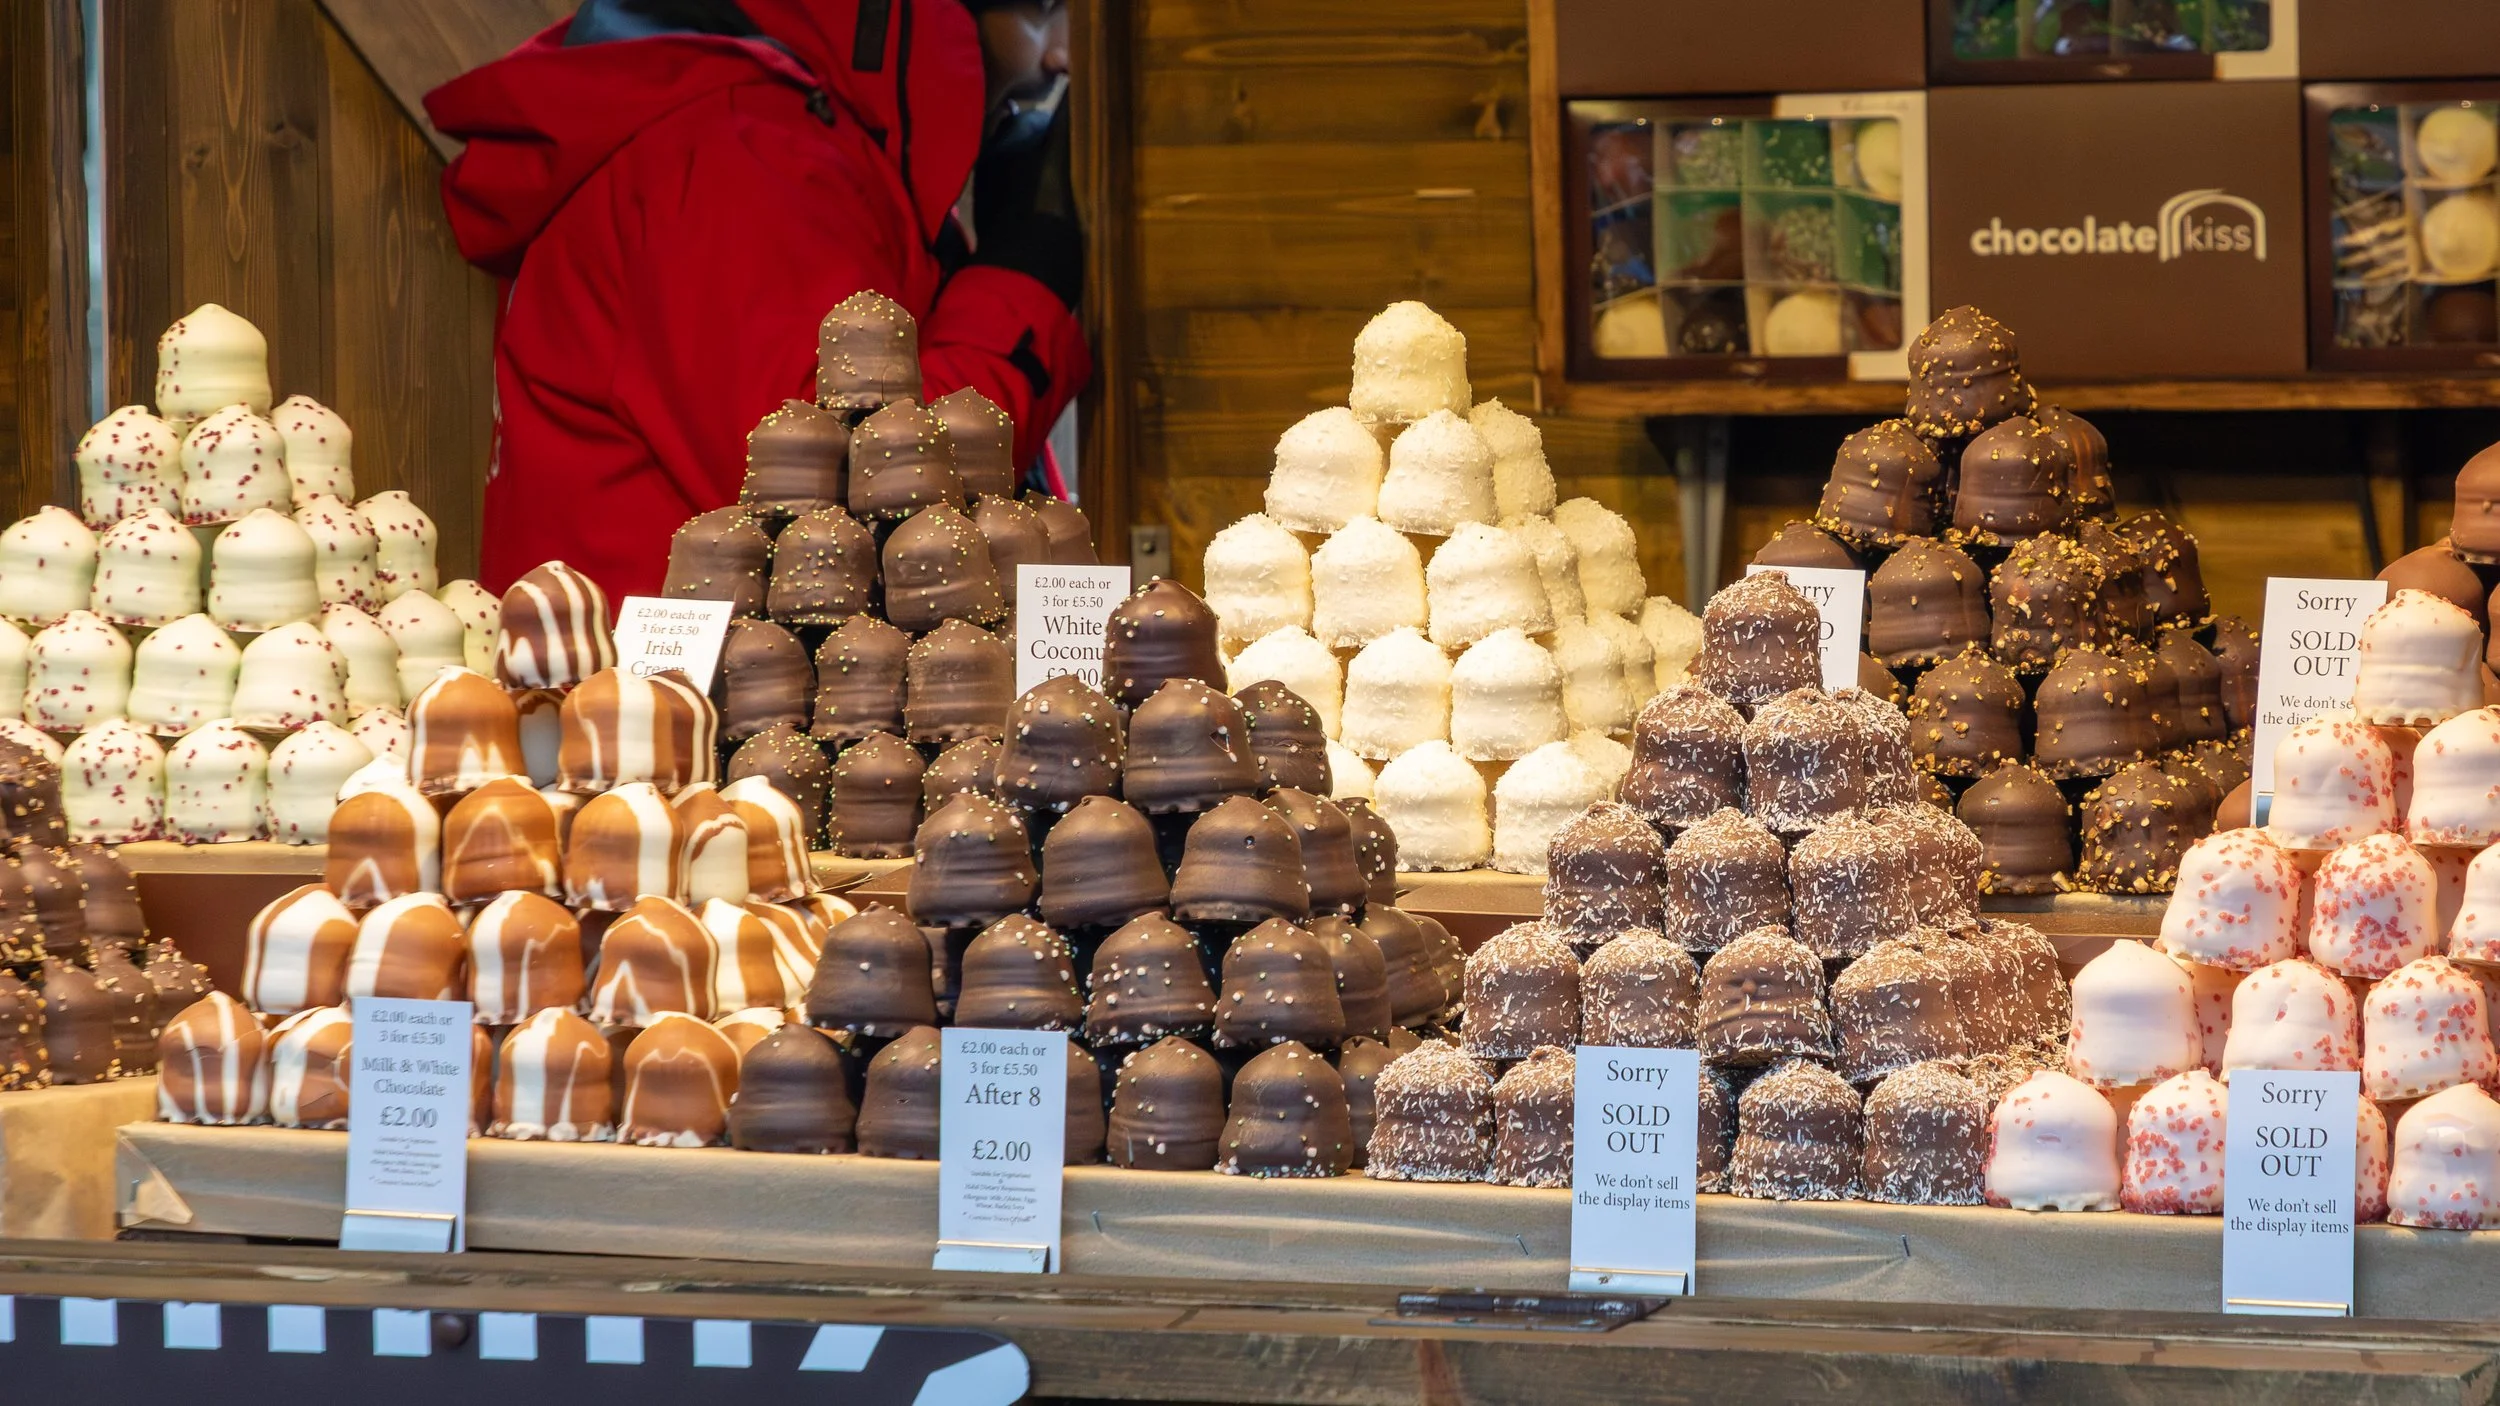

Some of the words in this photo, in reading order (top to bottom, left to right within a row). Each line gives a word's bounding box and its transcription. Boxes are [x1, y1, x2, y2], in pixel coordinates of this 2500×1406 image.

[1970, 215, 2157, 256] chocolate
[2183, 214, 2252, 251] kiss
[1035, 577, 1065, 588] £2.00
[1069, 577, 1094, 589] each
[1099, 581, 1111, 589] or
[1042, 596, 1048, 606] 3
[1053, 595, 1068, 606] for
[1072, 597, 1103, 607] £5.50
[2297, 590, 2358, 617] Sorry
[638, 608, 667, 618] £2.00
[670, 610, 695, 620] each
[640, 624, 646, 633] 3
[649, 624, 666, 634] for
[669, 626, 699, 635] £5.50
[1043, 615, 1102, 635] White
[645, 641, 683, 656] Irish
[2290, 630, 2356, 650] SOLD
[1031, 640, 1104, 660] Coconu
[2294, 656, 2350, 676] OUT
[2280, 695, 2300, 707] We
[2304, 696, 2336, 709] don't
[2340, 701, 2352, 709] se
[2263, 712, 2283, 724] the
[371, 1010, 406, 1022] £2.00
[409, 1012, 436, 1024] each
[439, 1017, 453, 1025] or
[379, 1030, 388, 1042] 3
[390, 1029, 408, 1043] for
[412, 1032, 445, 1045] £5.50
[961, 1042, 996, 1054] £2.00
[1000, 1043, 1028, 1055] each
[1033, 1047, 1047, 1056] or
[361, 1057, 397, 1071] Milk
[400, 1059, 412, 1072] &
[416, 1059, 459, 1075] White
[970, 1062, 977, 1073] 3
[981, 1061, 999, 1074] for
[1004, 1063, 1037, 1076] £5.50
[1607, 1060, 1669, 1090] Sorry
[373, 1079, 446, 1096] Chocolate
[965, 1083, 1021, 1105] After
[1029, 1087, 1040, 1106] 8
[2262, 1082, 2328, 1111] Sorry
[379, 1106, 438, 1128] £2.00
[1602, 1103, 1670, 1126] SOLD
[1607, 1132, 1664, 1154] OUT
[2256, 1126, 2328, 1148] SOLD
[972, 1140, 1031, 1161] £2.00
[2261, 1155, 2322, 1177] OUT
[1595, 1174, 1616, 1187] We
[1620, 1175, 1652, 1188] don't
[1657, 1177, 1678, 1189] sell
[1579, 1191, 1599, 1205] the
[1604, 1193, 1650, 1211] display
[1655, 1196, 1689, 1209] items
[2248, 1199, 2270, 1212] We
[2275, 1199, 2309, 1213] don't
[2314, 1200, 2336, 1214] sell
[2231, 1217, 2252, 1231] the
[2257, 1217, 2306, 1236] display
[2311, 1220, 2349, 1233] items
